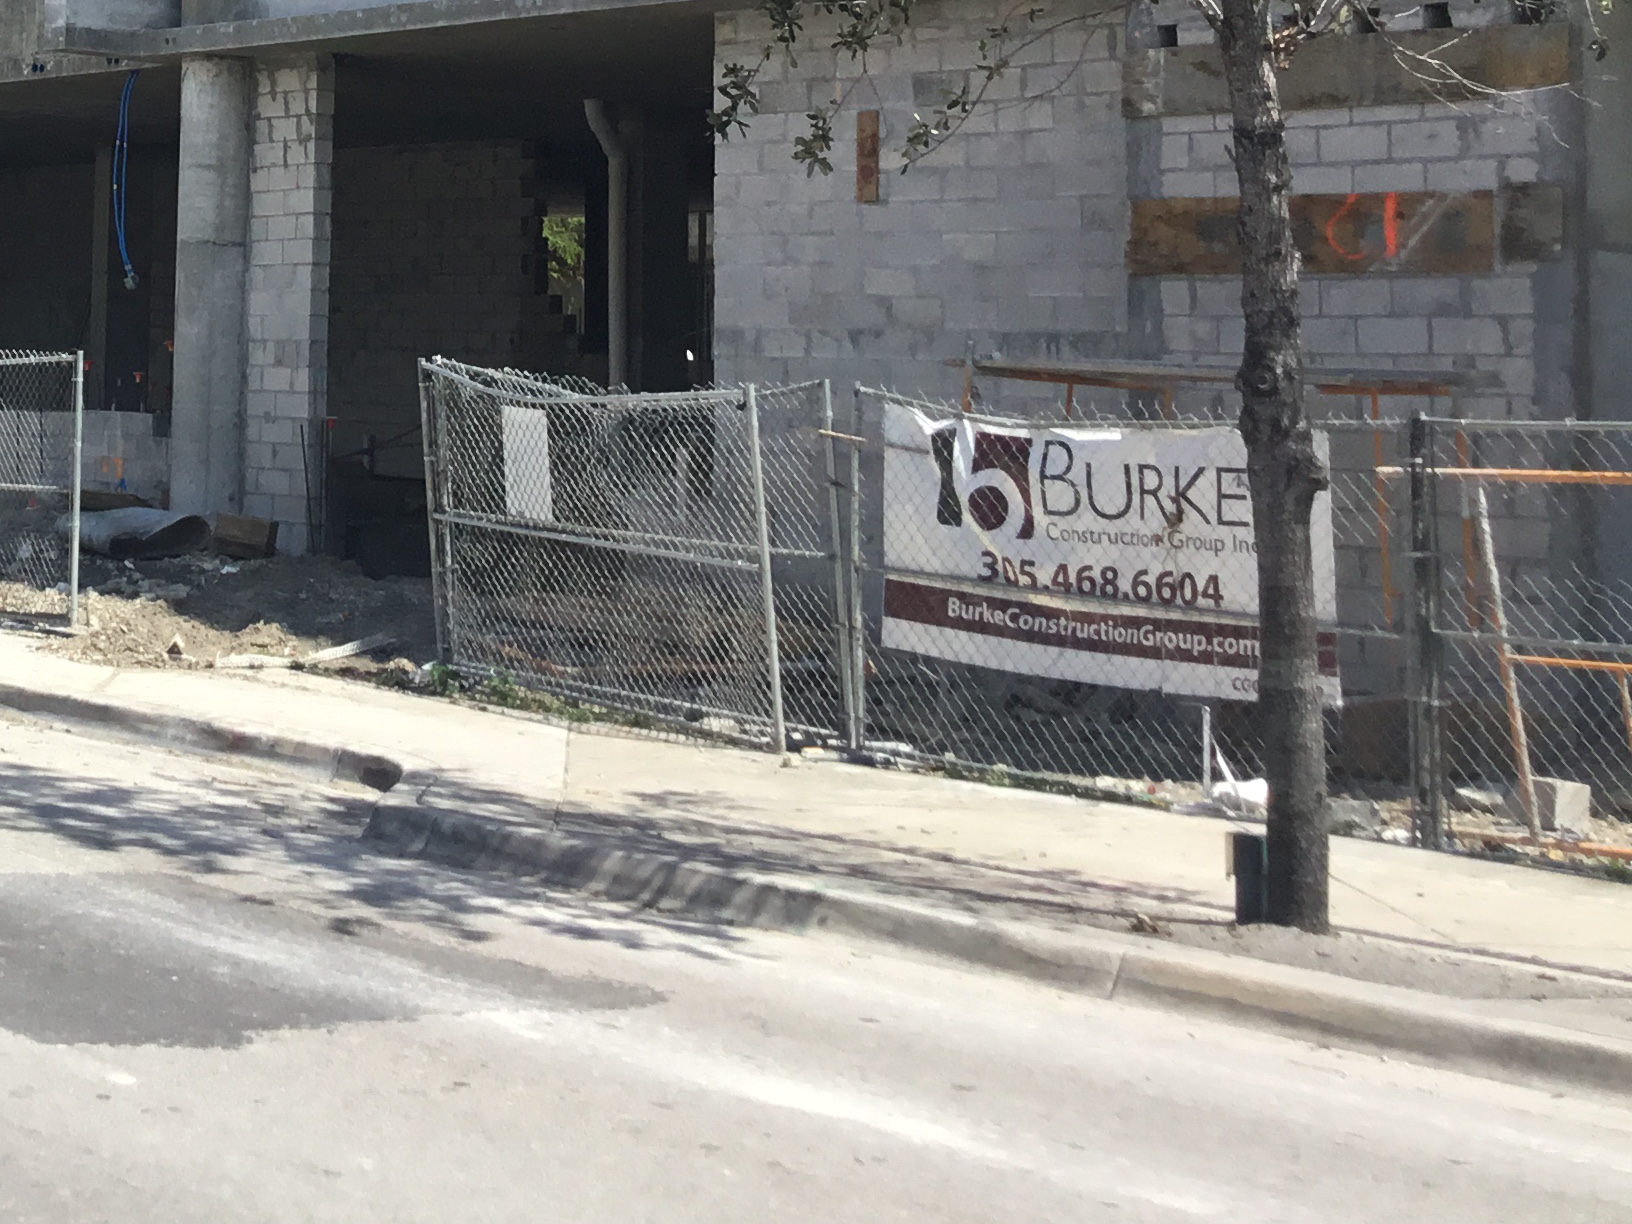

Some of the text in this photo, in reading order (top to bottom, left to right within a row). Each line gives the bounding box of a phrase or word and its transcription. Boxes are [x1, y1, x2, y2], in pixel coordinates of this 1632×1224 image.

[1039, 440, 1250, 527] BURKE
[1046, 522, 1161, 547] Construction
[1168, 529, 1225, 557] Group
[977, 549, 1224, 608] 305.468.6604
[947, 596, 1260, 657] BurkeConstructionGroup.com
